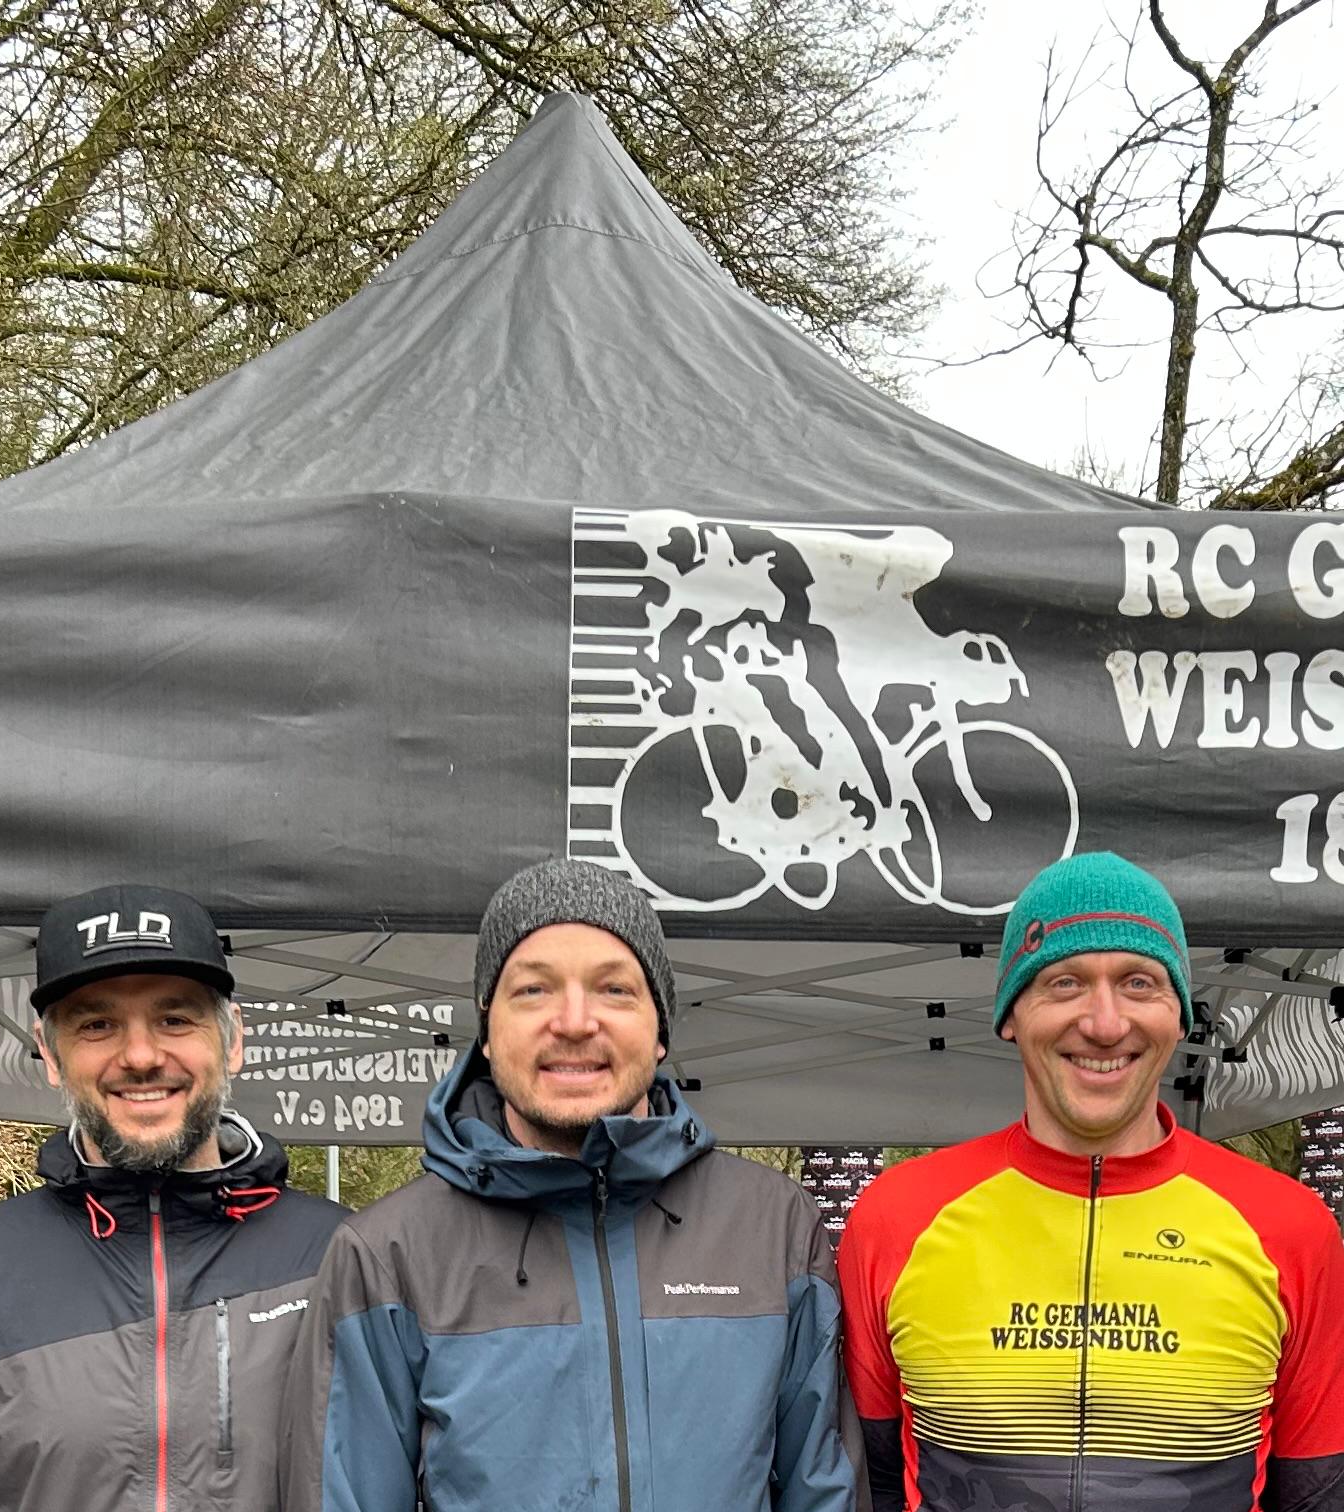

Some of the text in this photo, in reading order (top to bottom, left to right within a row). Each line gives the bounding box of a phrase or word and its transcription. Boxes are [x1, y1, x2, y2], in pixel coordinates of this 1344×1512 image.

[1117, 522, 1256, 620] RC
[77, 911, 172, 948] TLD
[1123, 1251, 1213, 1267] ENDURA
[1010, 1302, 1162, 1328] RC GERMANIA
[990, 1327, 1181, 1354] WEISSENBURG
